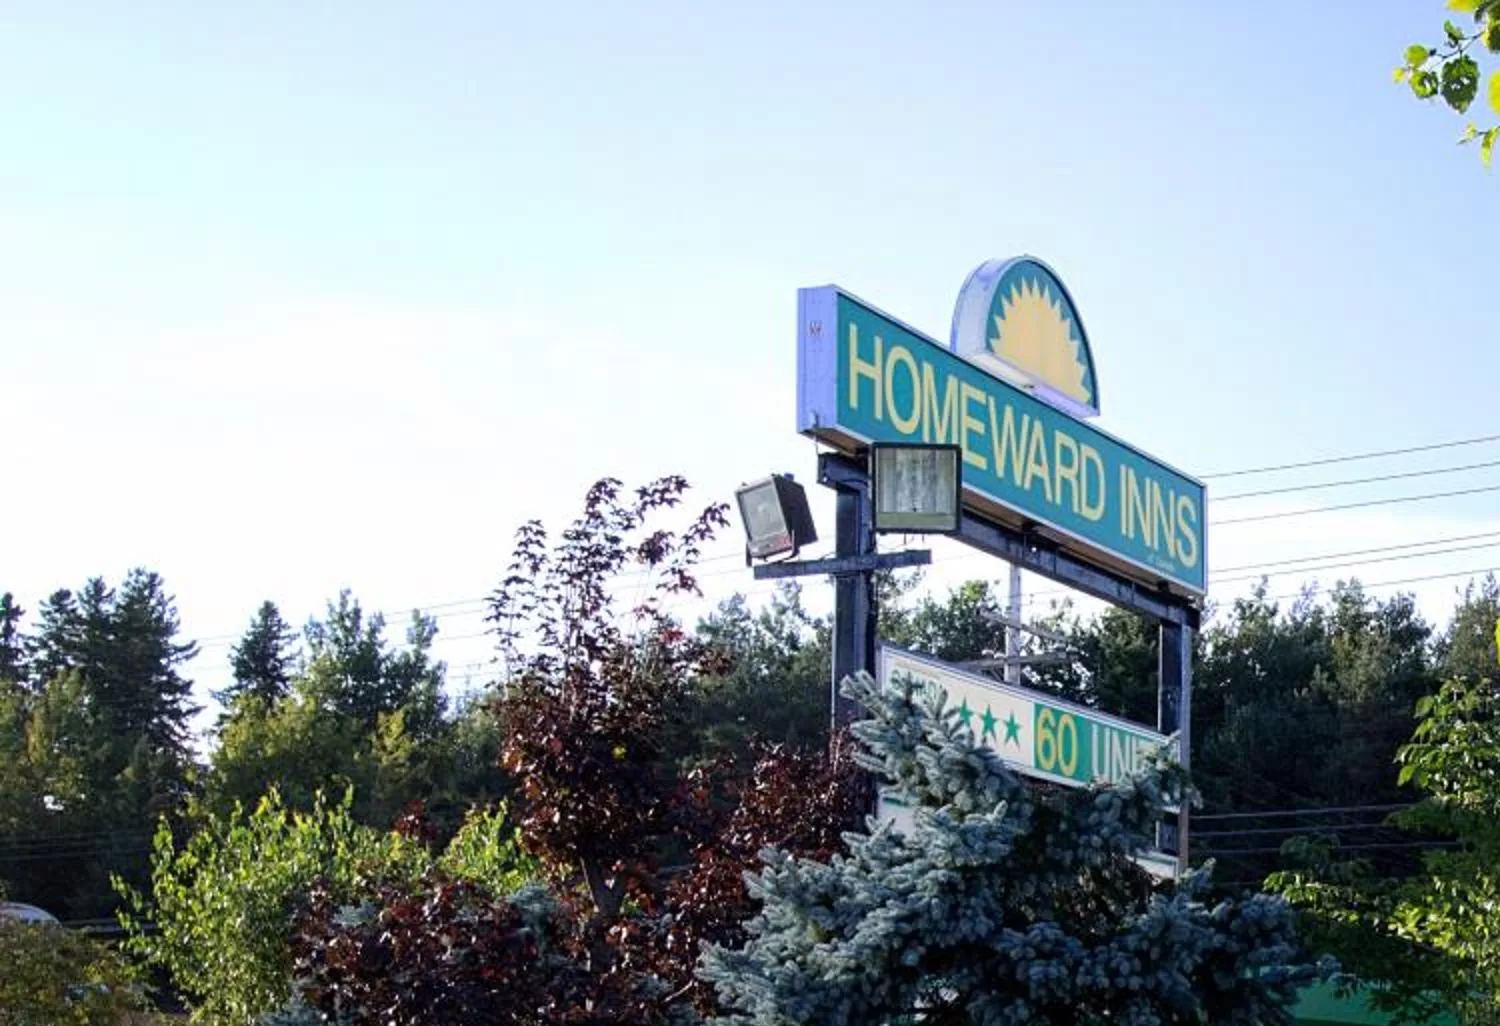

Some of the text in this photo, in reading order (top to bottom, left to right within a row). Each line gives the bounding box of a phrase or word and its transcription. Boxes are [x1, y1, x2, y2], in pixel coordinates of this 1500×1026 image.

[848, 321, 1198, 568] HOMEWARD INNS
[1035, 706, 1079, 776] 60
